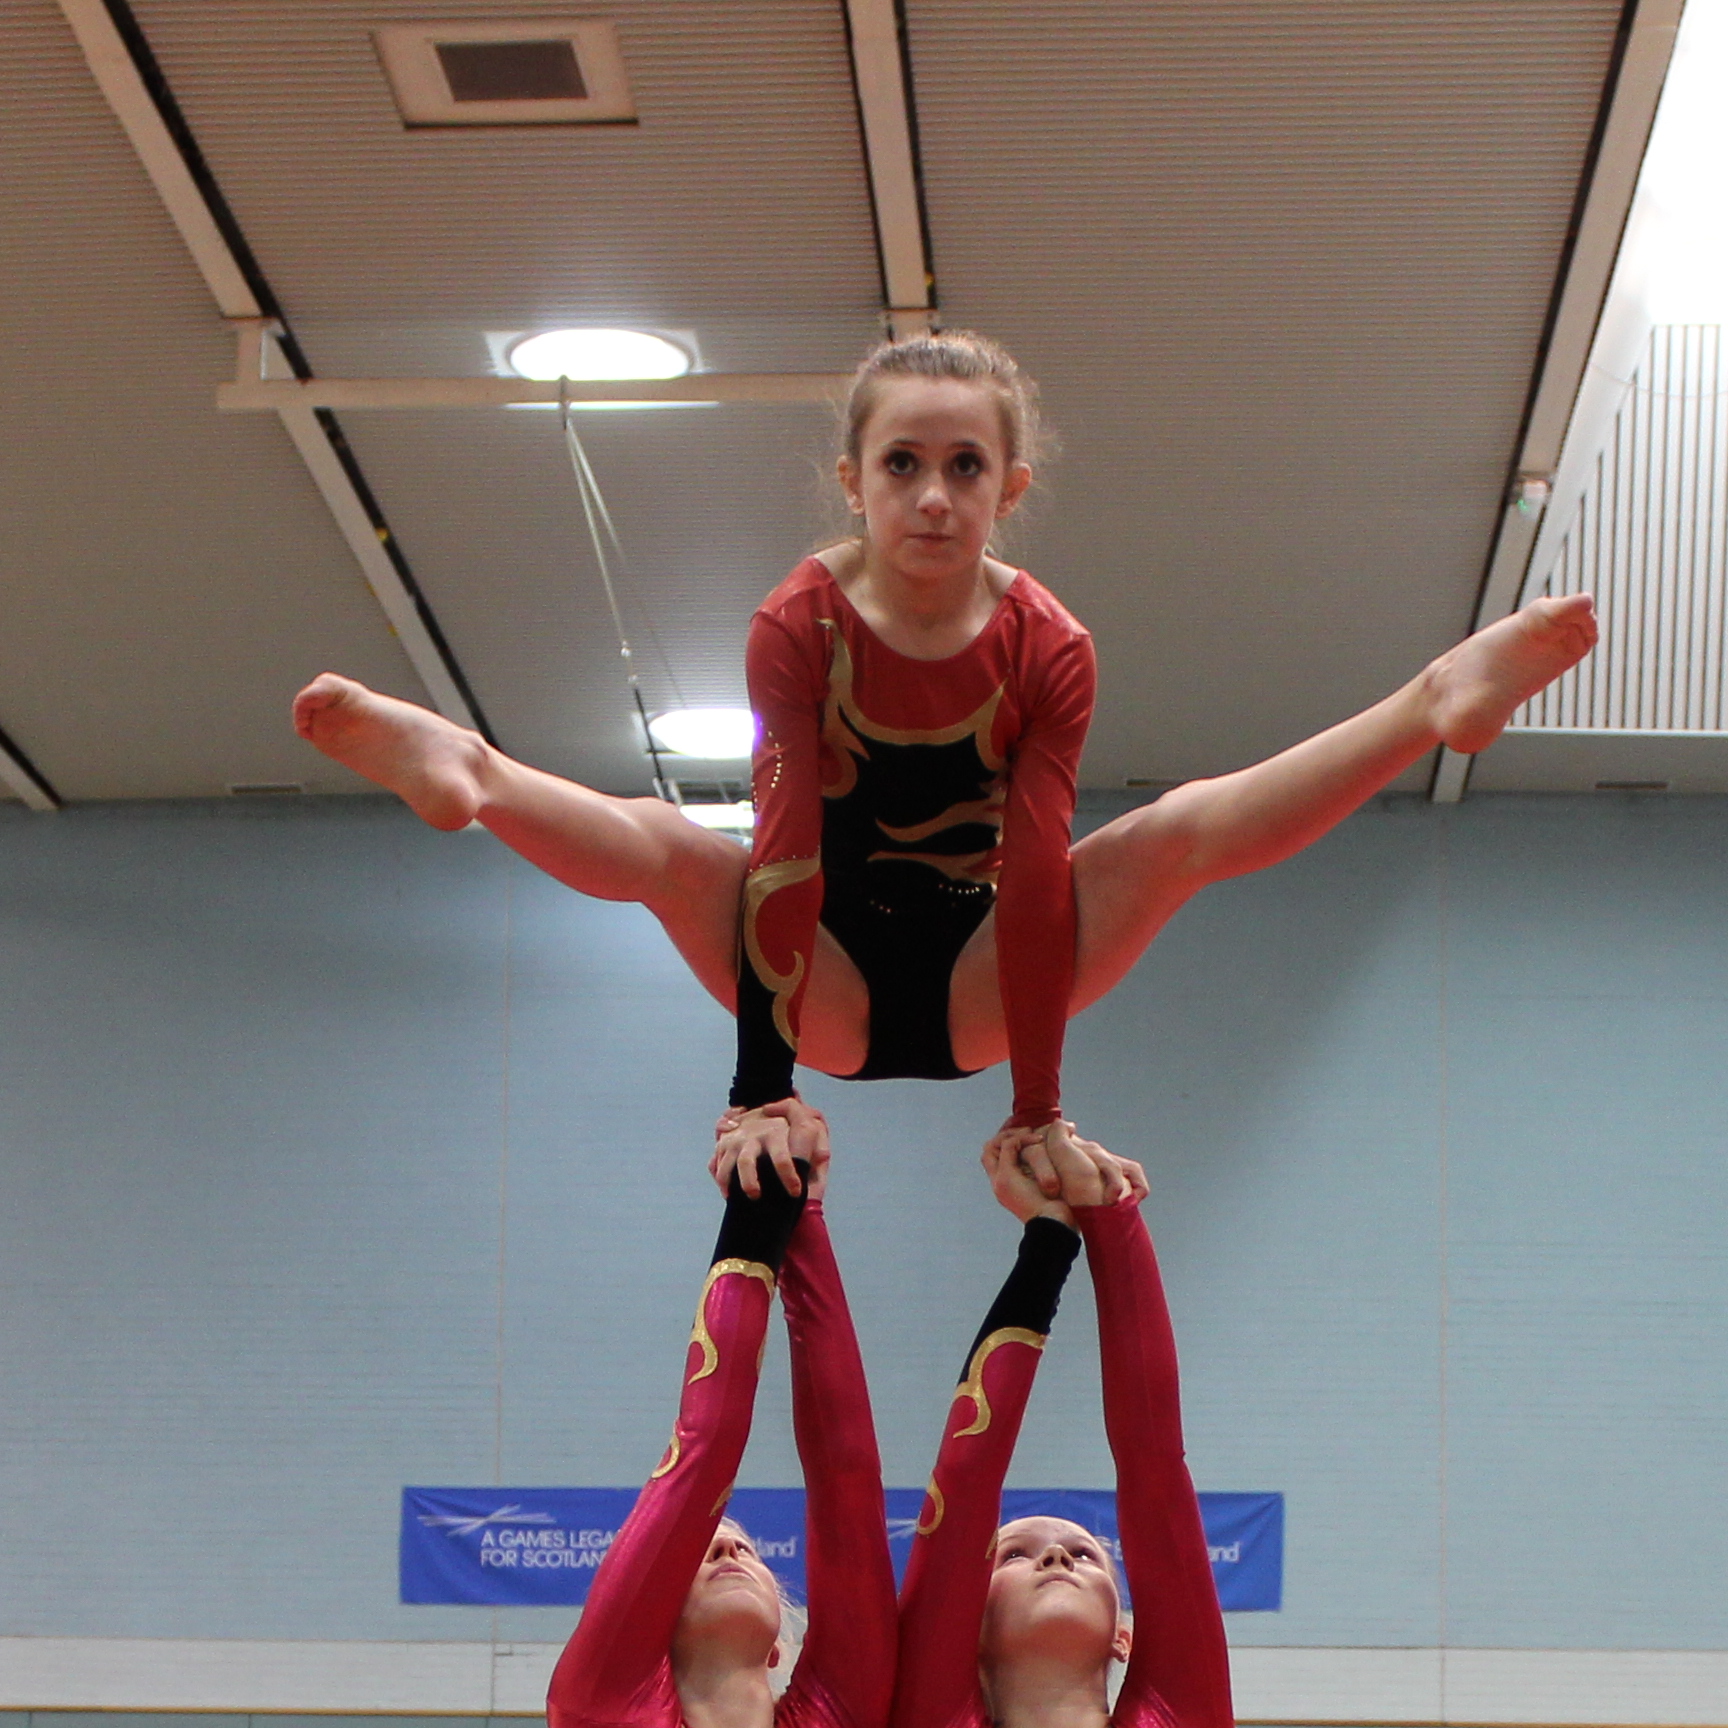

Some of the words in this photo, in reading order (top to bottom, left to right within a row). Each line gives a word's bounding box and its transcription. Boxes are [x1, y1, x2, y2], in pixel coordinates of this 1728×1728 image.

[481, 1530, 495, 1547] A
[499, 1530, 565, 1548] GAMES
[569, 1530, 615, 1548] LEGA
[481, 1550, 517, 1567] FOR
[522, 1550, 607, 1568] SCOTLAN
